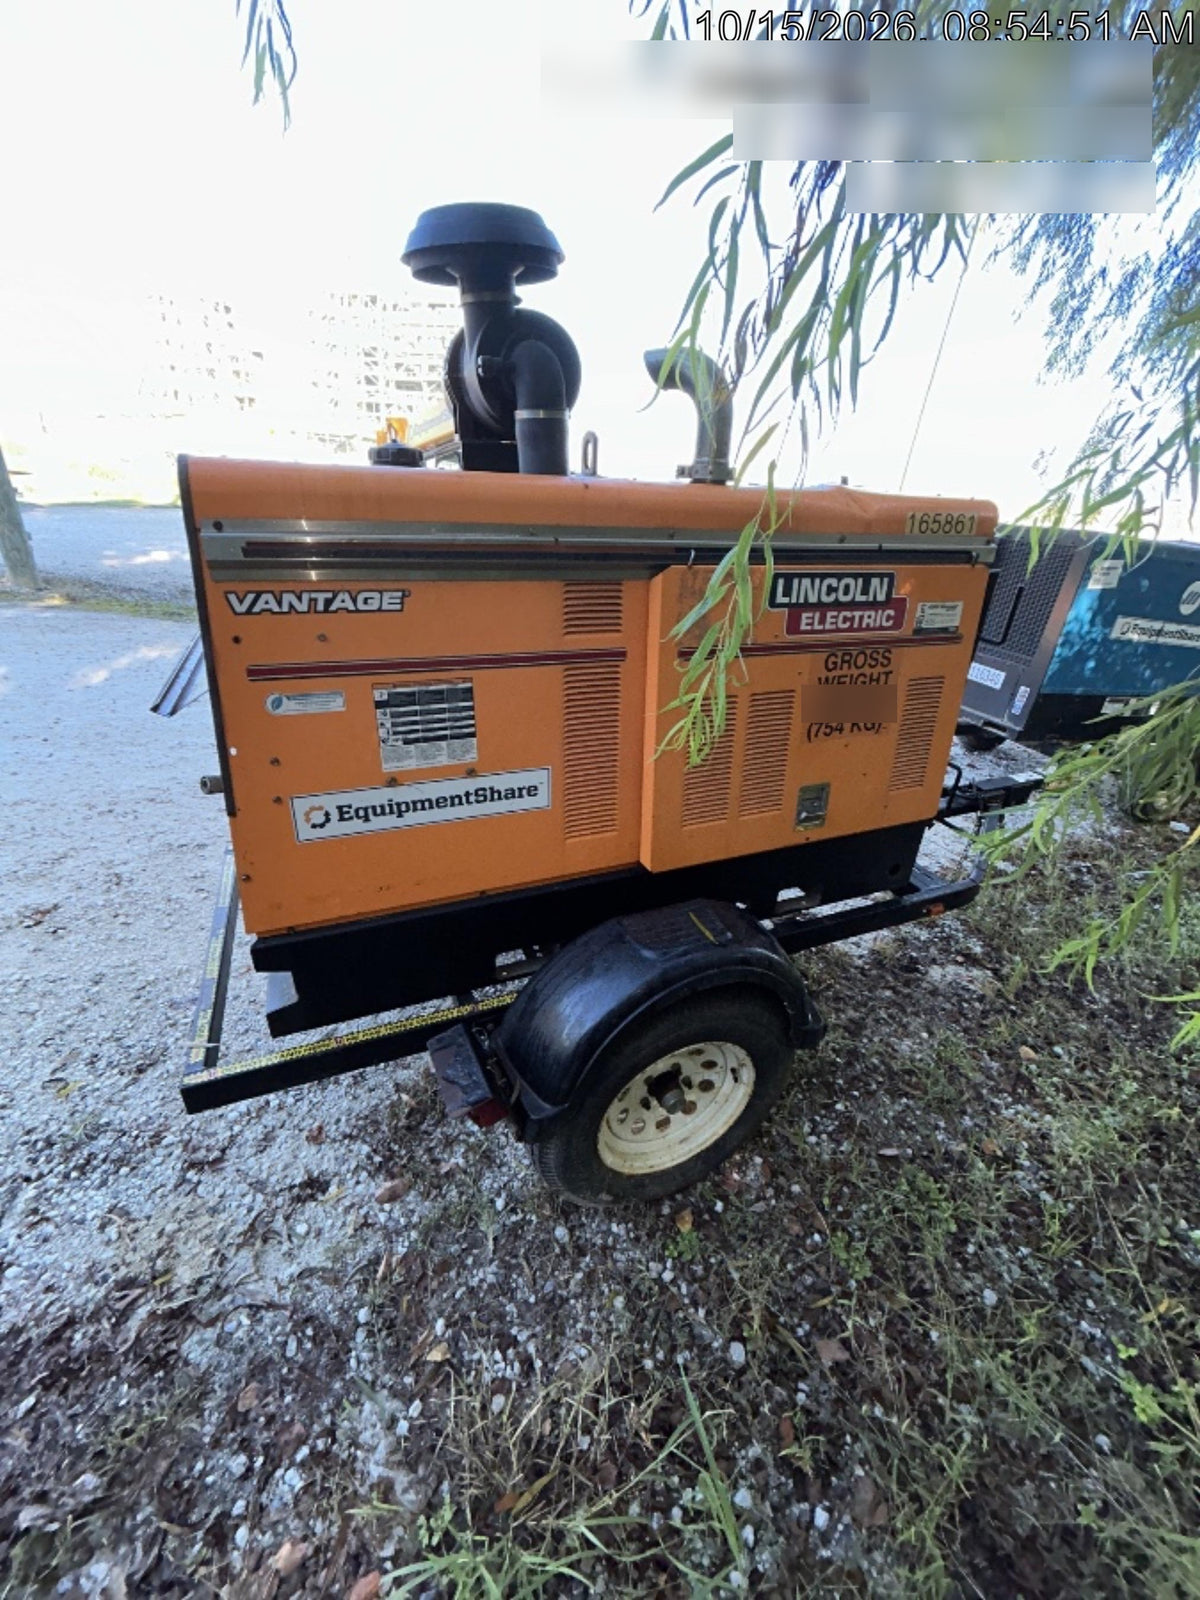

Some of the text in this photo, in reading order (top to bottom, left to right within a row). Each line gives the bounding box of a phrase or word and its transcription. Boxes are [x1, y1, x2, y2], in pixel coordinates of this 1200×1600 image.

[908, 513, 976, 535] 165861
[775, 577, 889, 604] LINCOLN
[225, 591, 404, 615] VANTAGE
[800, 609, 896, 631] ELECTRIC
[824, 648, 892, 672] GROSS
[335, 782, 541, 824] EquipmentShare
